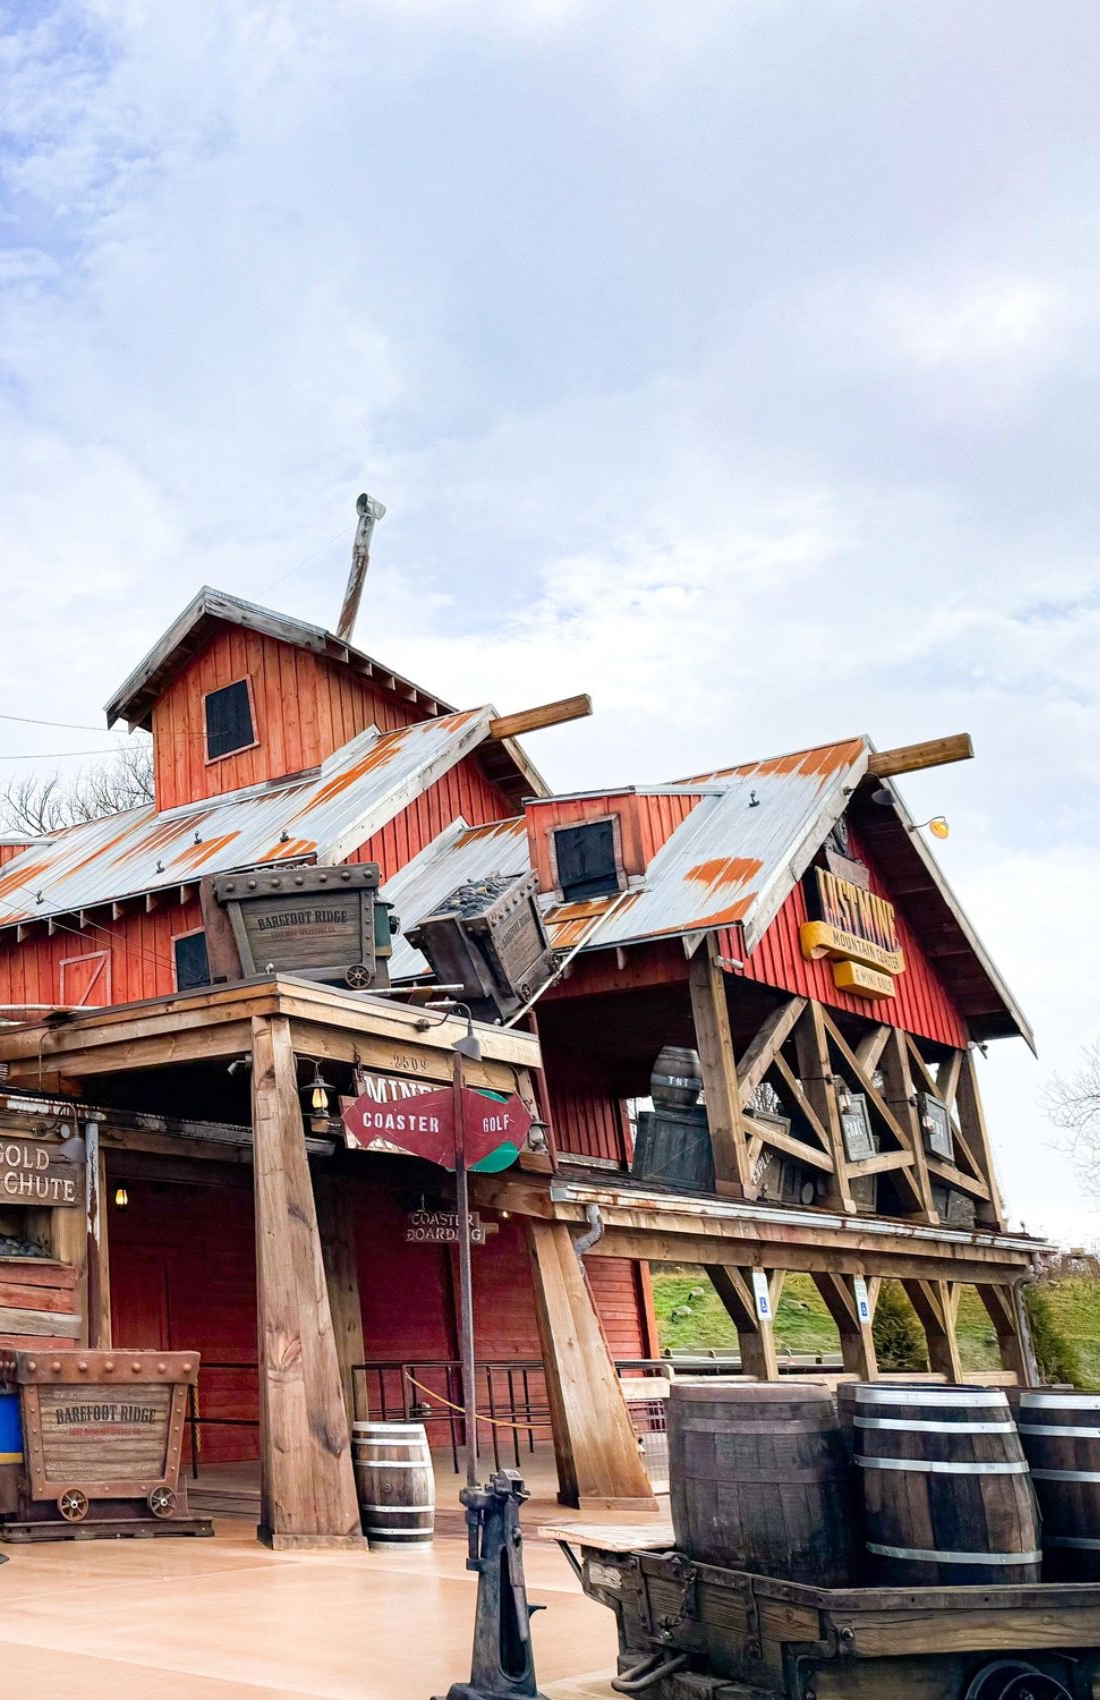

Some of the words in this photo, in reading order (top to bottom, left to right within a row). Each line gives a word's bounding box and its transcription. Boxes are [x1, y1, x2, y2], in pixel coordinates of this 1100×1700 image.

[257, 910, 313, 931] BAREFOOT
[314, 909, 348, 923] RIDGE
[667, 1075, 689, 1087] TNT
[362, 1112, 440, 1133] COASTER
[482, 1113, 510, 1133] GOLF
[3, 1172, 76, 1202] CHUTE
[55, 1404, 118, 1425] BAREFOOT
[120, 1404, 156, 1424] RIDGE
